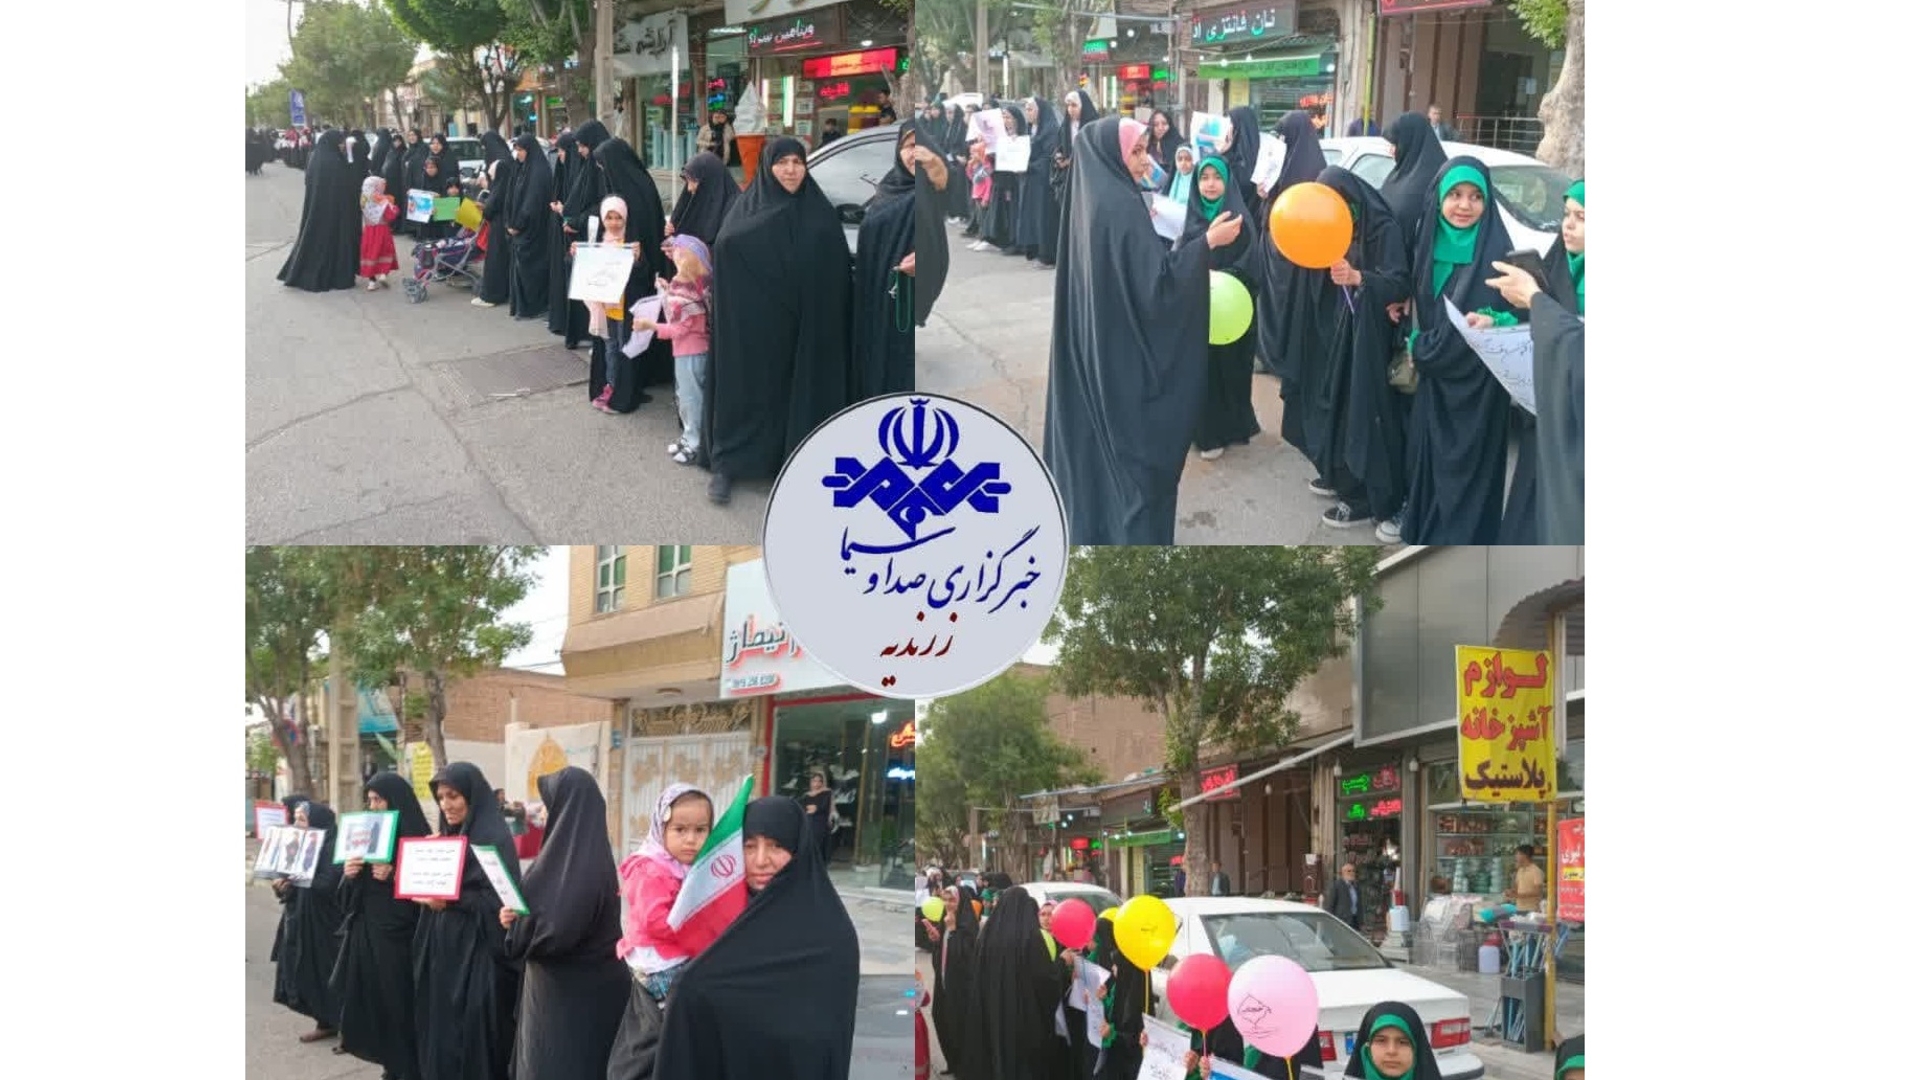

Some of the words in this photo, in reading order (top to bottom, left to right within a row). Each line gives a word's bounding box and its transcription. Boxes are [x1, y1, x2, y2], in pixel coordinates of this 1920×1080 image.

[1206, 9, 1248, 42] فانتزی
[1251, 8, 1276, 36] نان
[1463, 650, 1550, 699] لوازم
[1465, 757, 1547, 799] پلاستیک
